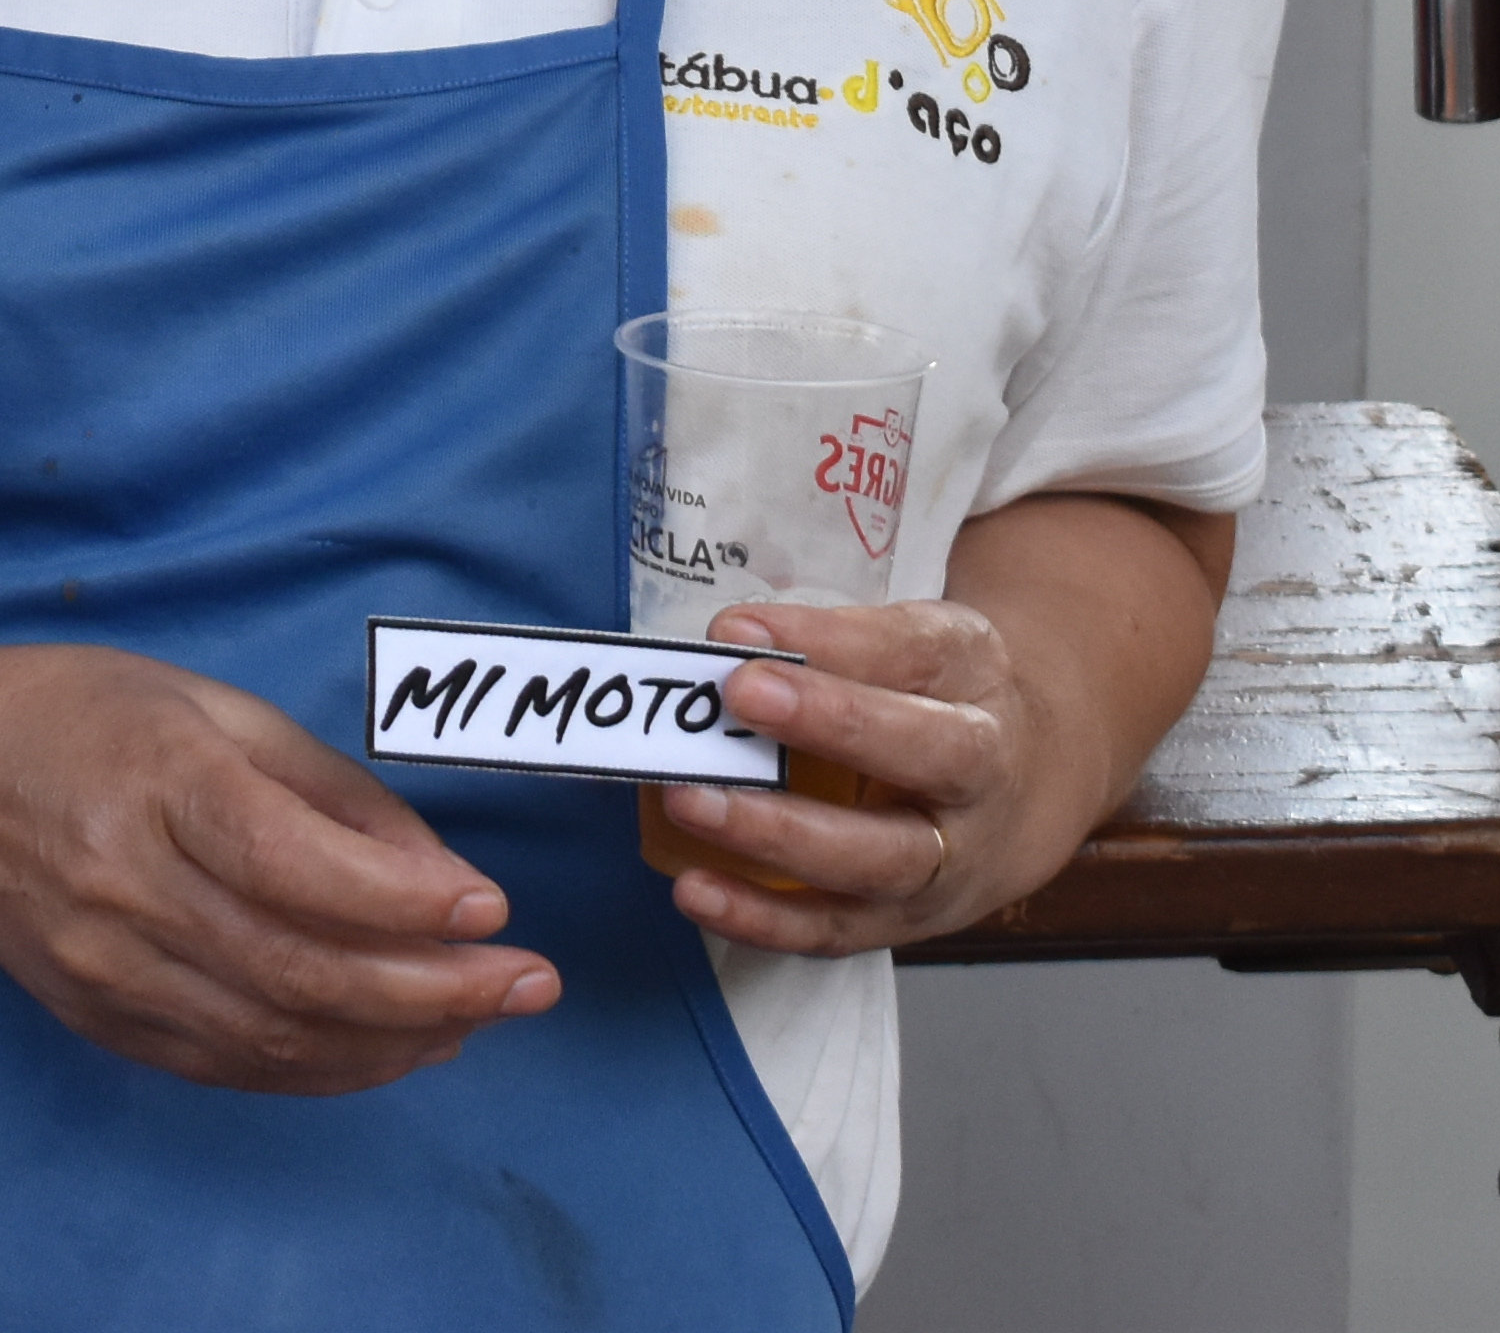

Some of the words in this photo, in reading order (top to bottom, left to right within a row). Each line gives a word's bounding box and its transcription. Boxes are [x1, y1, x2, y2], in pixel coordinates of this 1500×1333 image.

[660, 52, 820, 105] tábua
[663, 94, 819, 129] estaurante
[666, 486, 706, 508] VIDA
[380, 658, 506, 739] MI
[504, 666, 757, 745] MOTO
